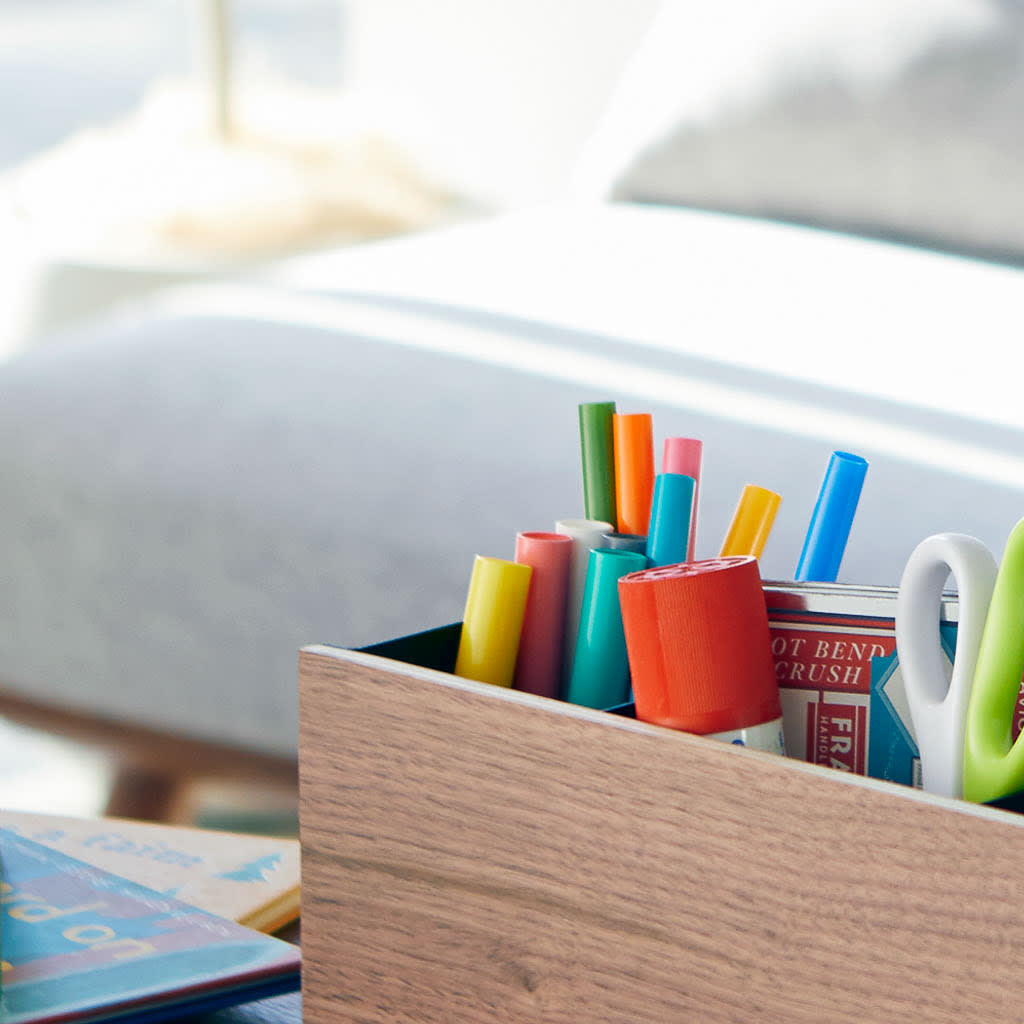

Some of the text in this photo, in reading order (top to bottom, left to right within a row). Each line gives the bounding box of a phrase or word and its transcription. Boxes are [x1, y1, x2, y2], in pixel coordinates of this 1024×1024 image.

[771, 636, 886, 662] OT BEND
[775, 660, 863, 685] CRUSH
